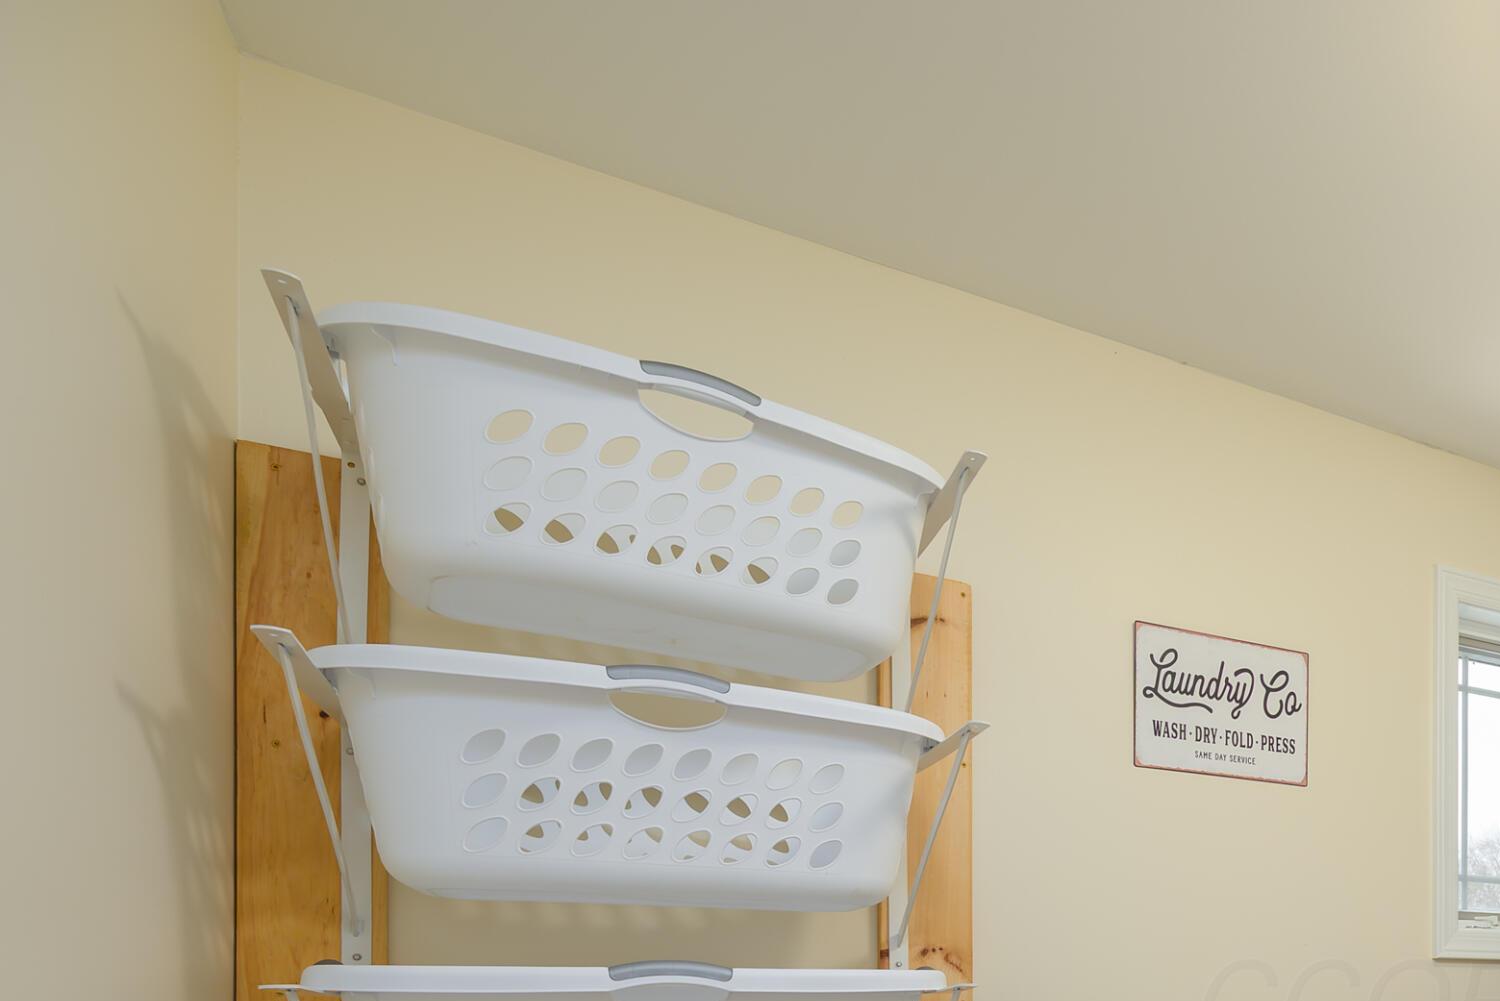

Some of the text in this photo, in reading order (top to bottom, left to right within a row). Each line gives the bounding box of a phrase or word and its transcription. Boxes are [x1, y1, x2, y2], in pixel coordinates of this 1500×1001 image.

[1142, 648, 1302, 719] Laundry Co
[1194, 750, 1256, 766] SAME DAY SERVICE
